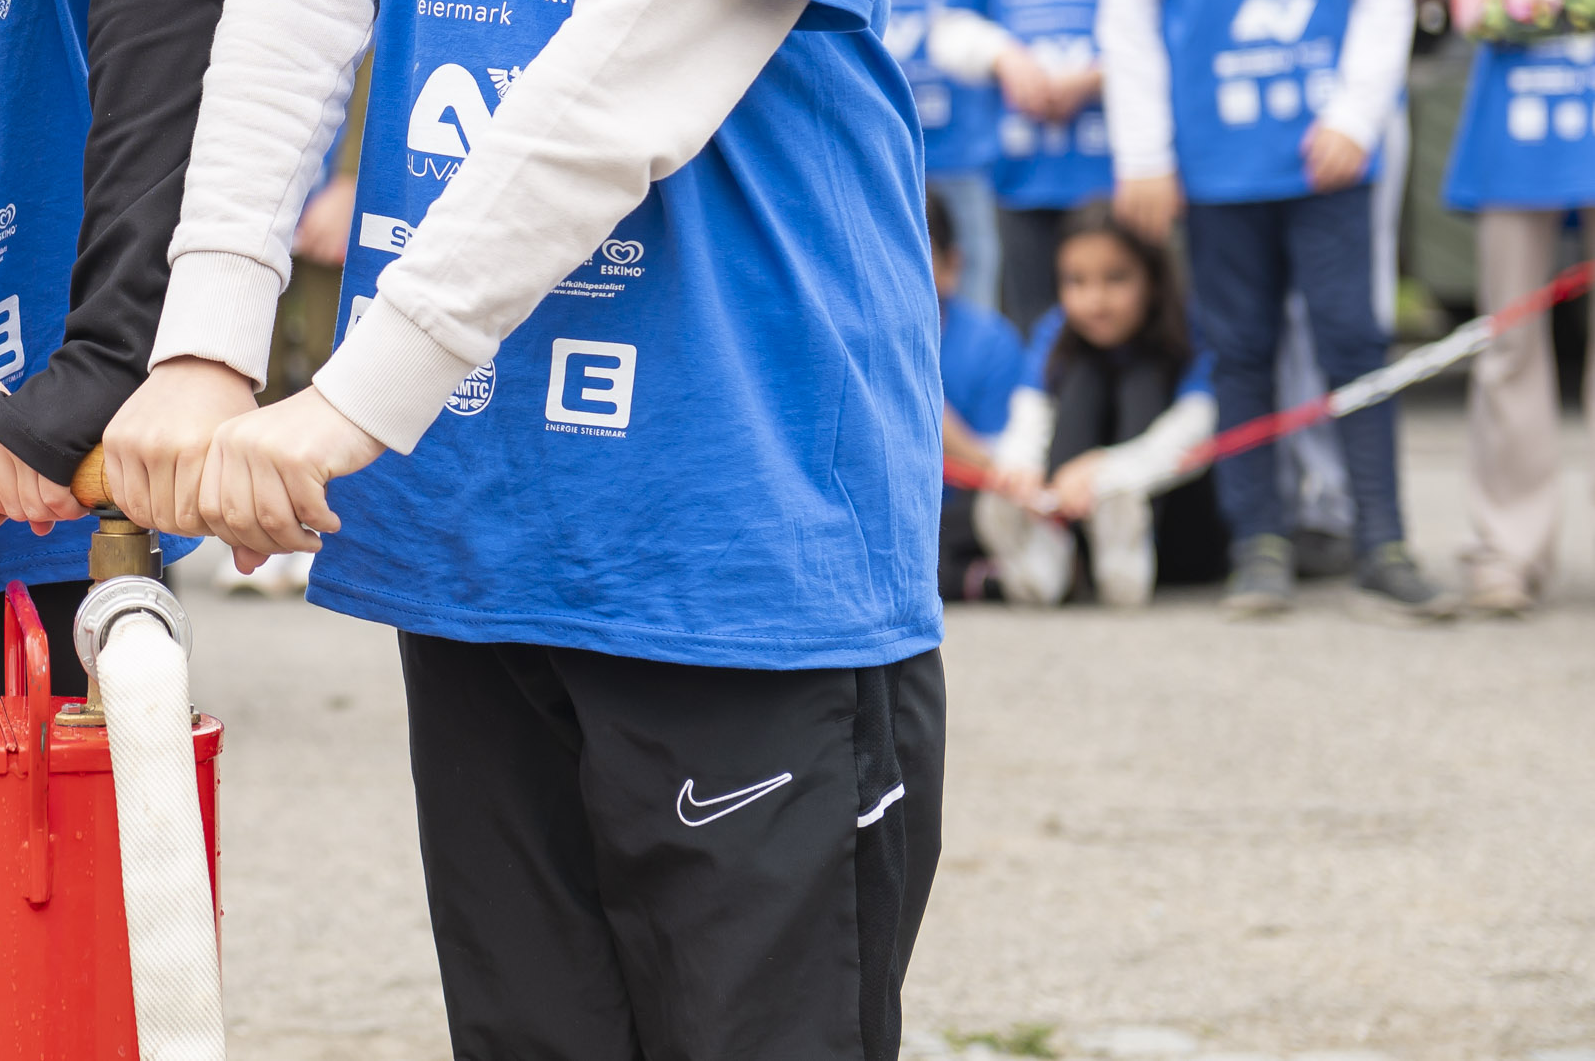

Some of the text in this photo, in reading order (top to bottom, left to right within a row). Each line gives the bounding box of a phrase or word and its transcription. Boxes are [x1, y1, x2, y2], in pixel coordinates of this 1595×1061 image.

[600, 265, 642, 278] ESKIMO
[558, 281, 625, 291] efkühlspezialist!
[456, 380, 489, 399] MTC
[545, 423, 627, 438] ENERGIE STEIERMARK
